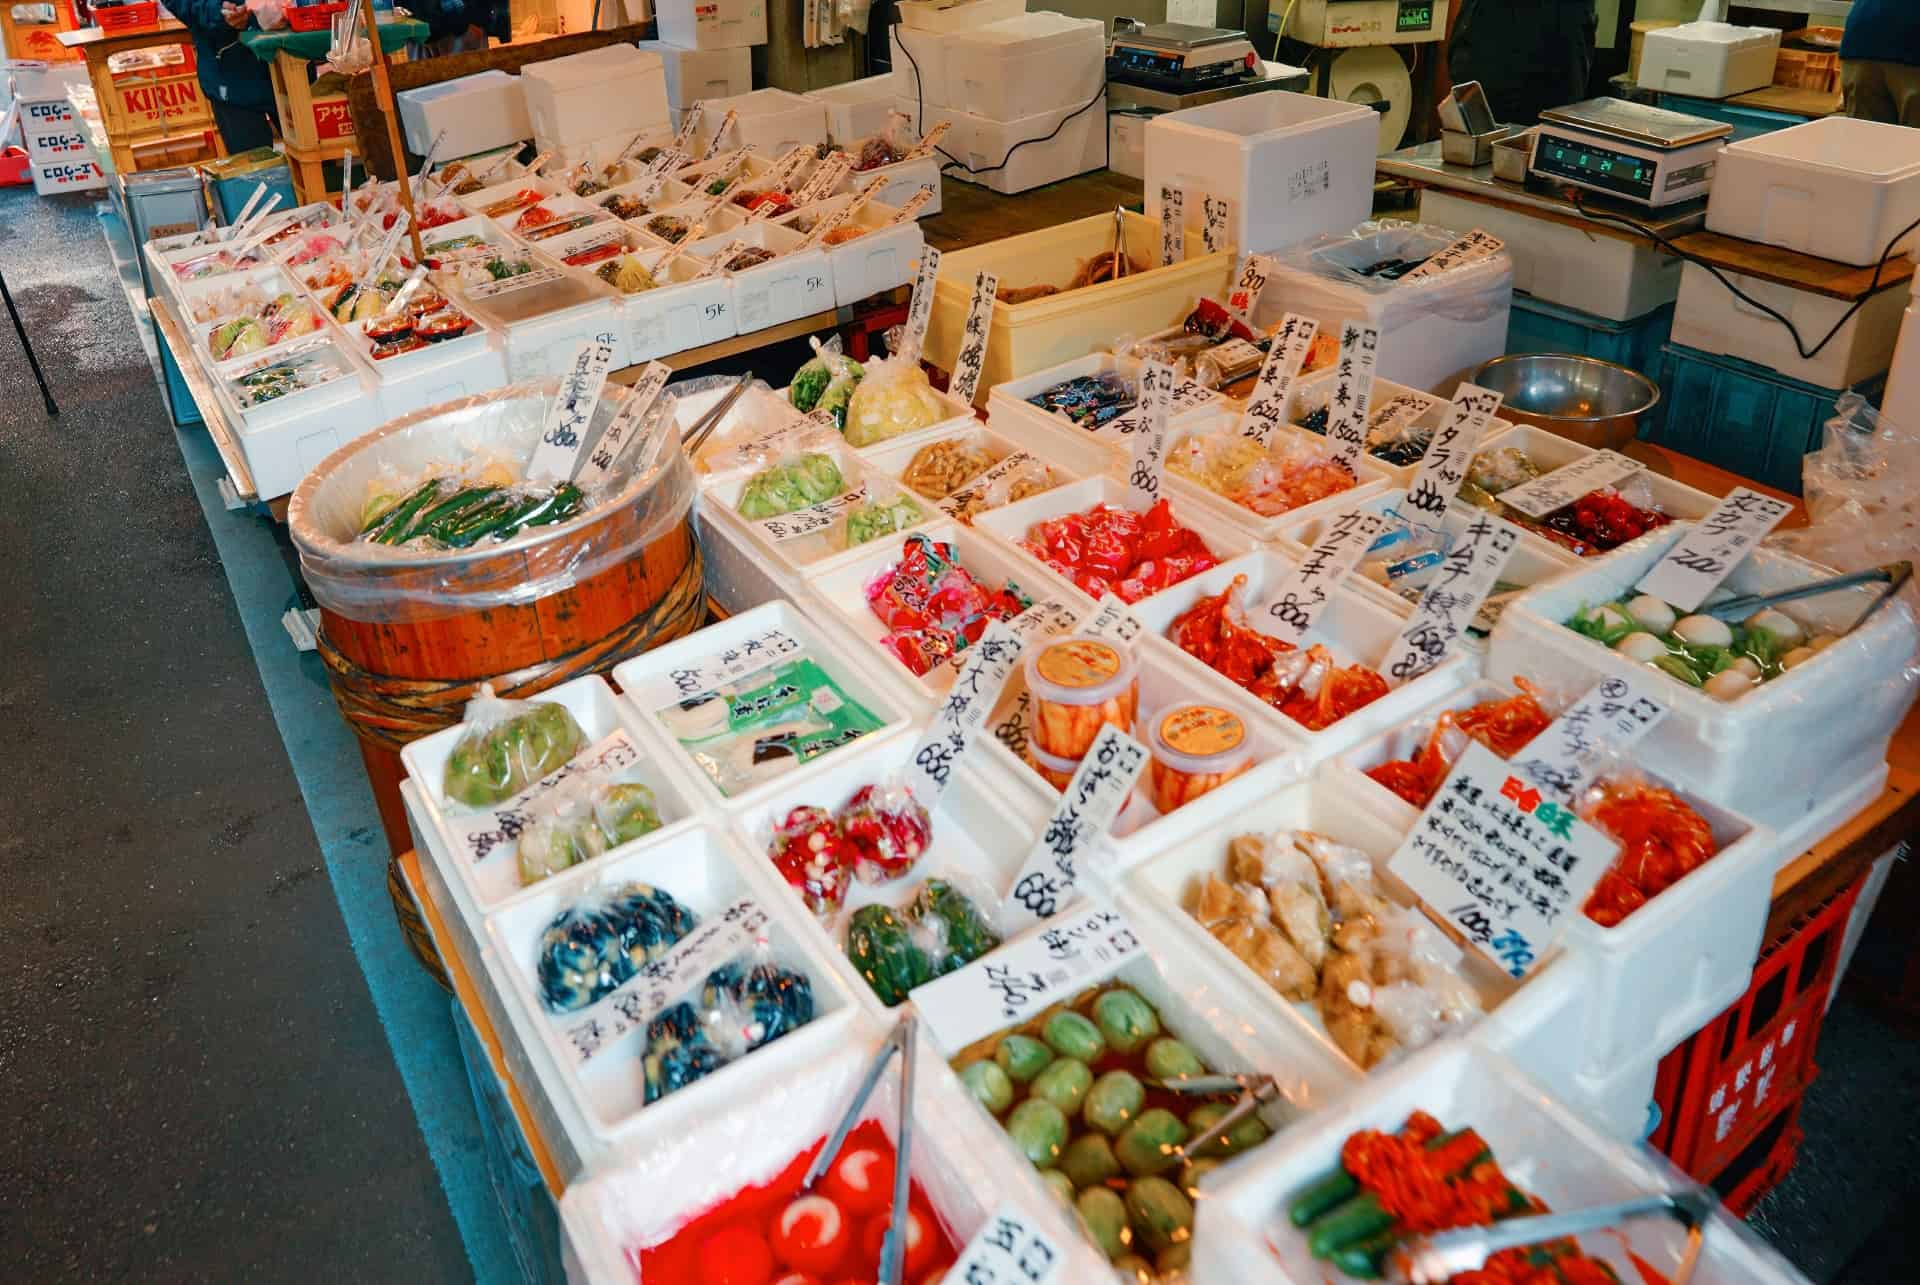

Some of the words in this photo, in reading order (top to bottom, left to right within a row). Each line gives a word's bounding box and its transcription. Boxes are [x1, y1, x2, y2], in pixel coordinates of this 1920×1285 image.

[123, 82, 198, 113] KIRIN
[704, 302, 728, 321] 5K
[1138, 367, 1158, 433] 赤かぶ
[1299, 510, 1362, 584] カクテキ
